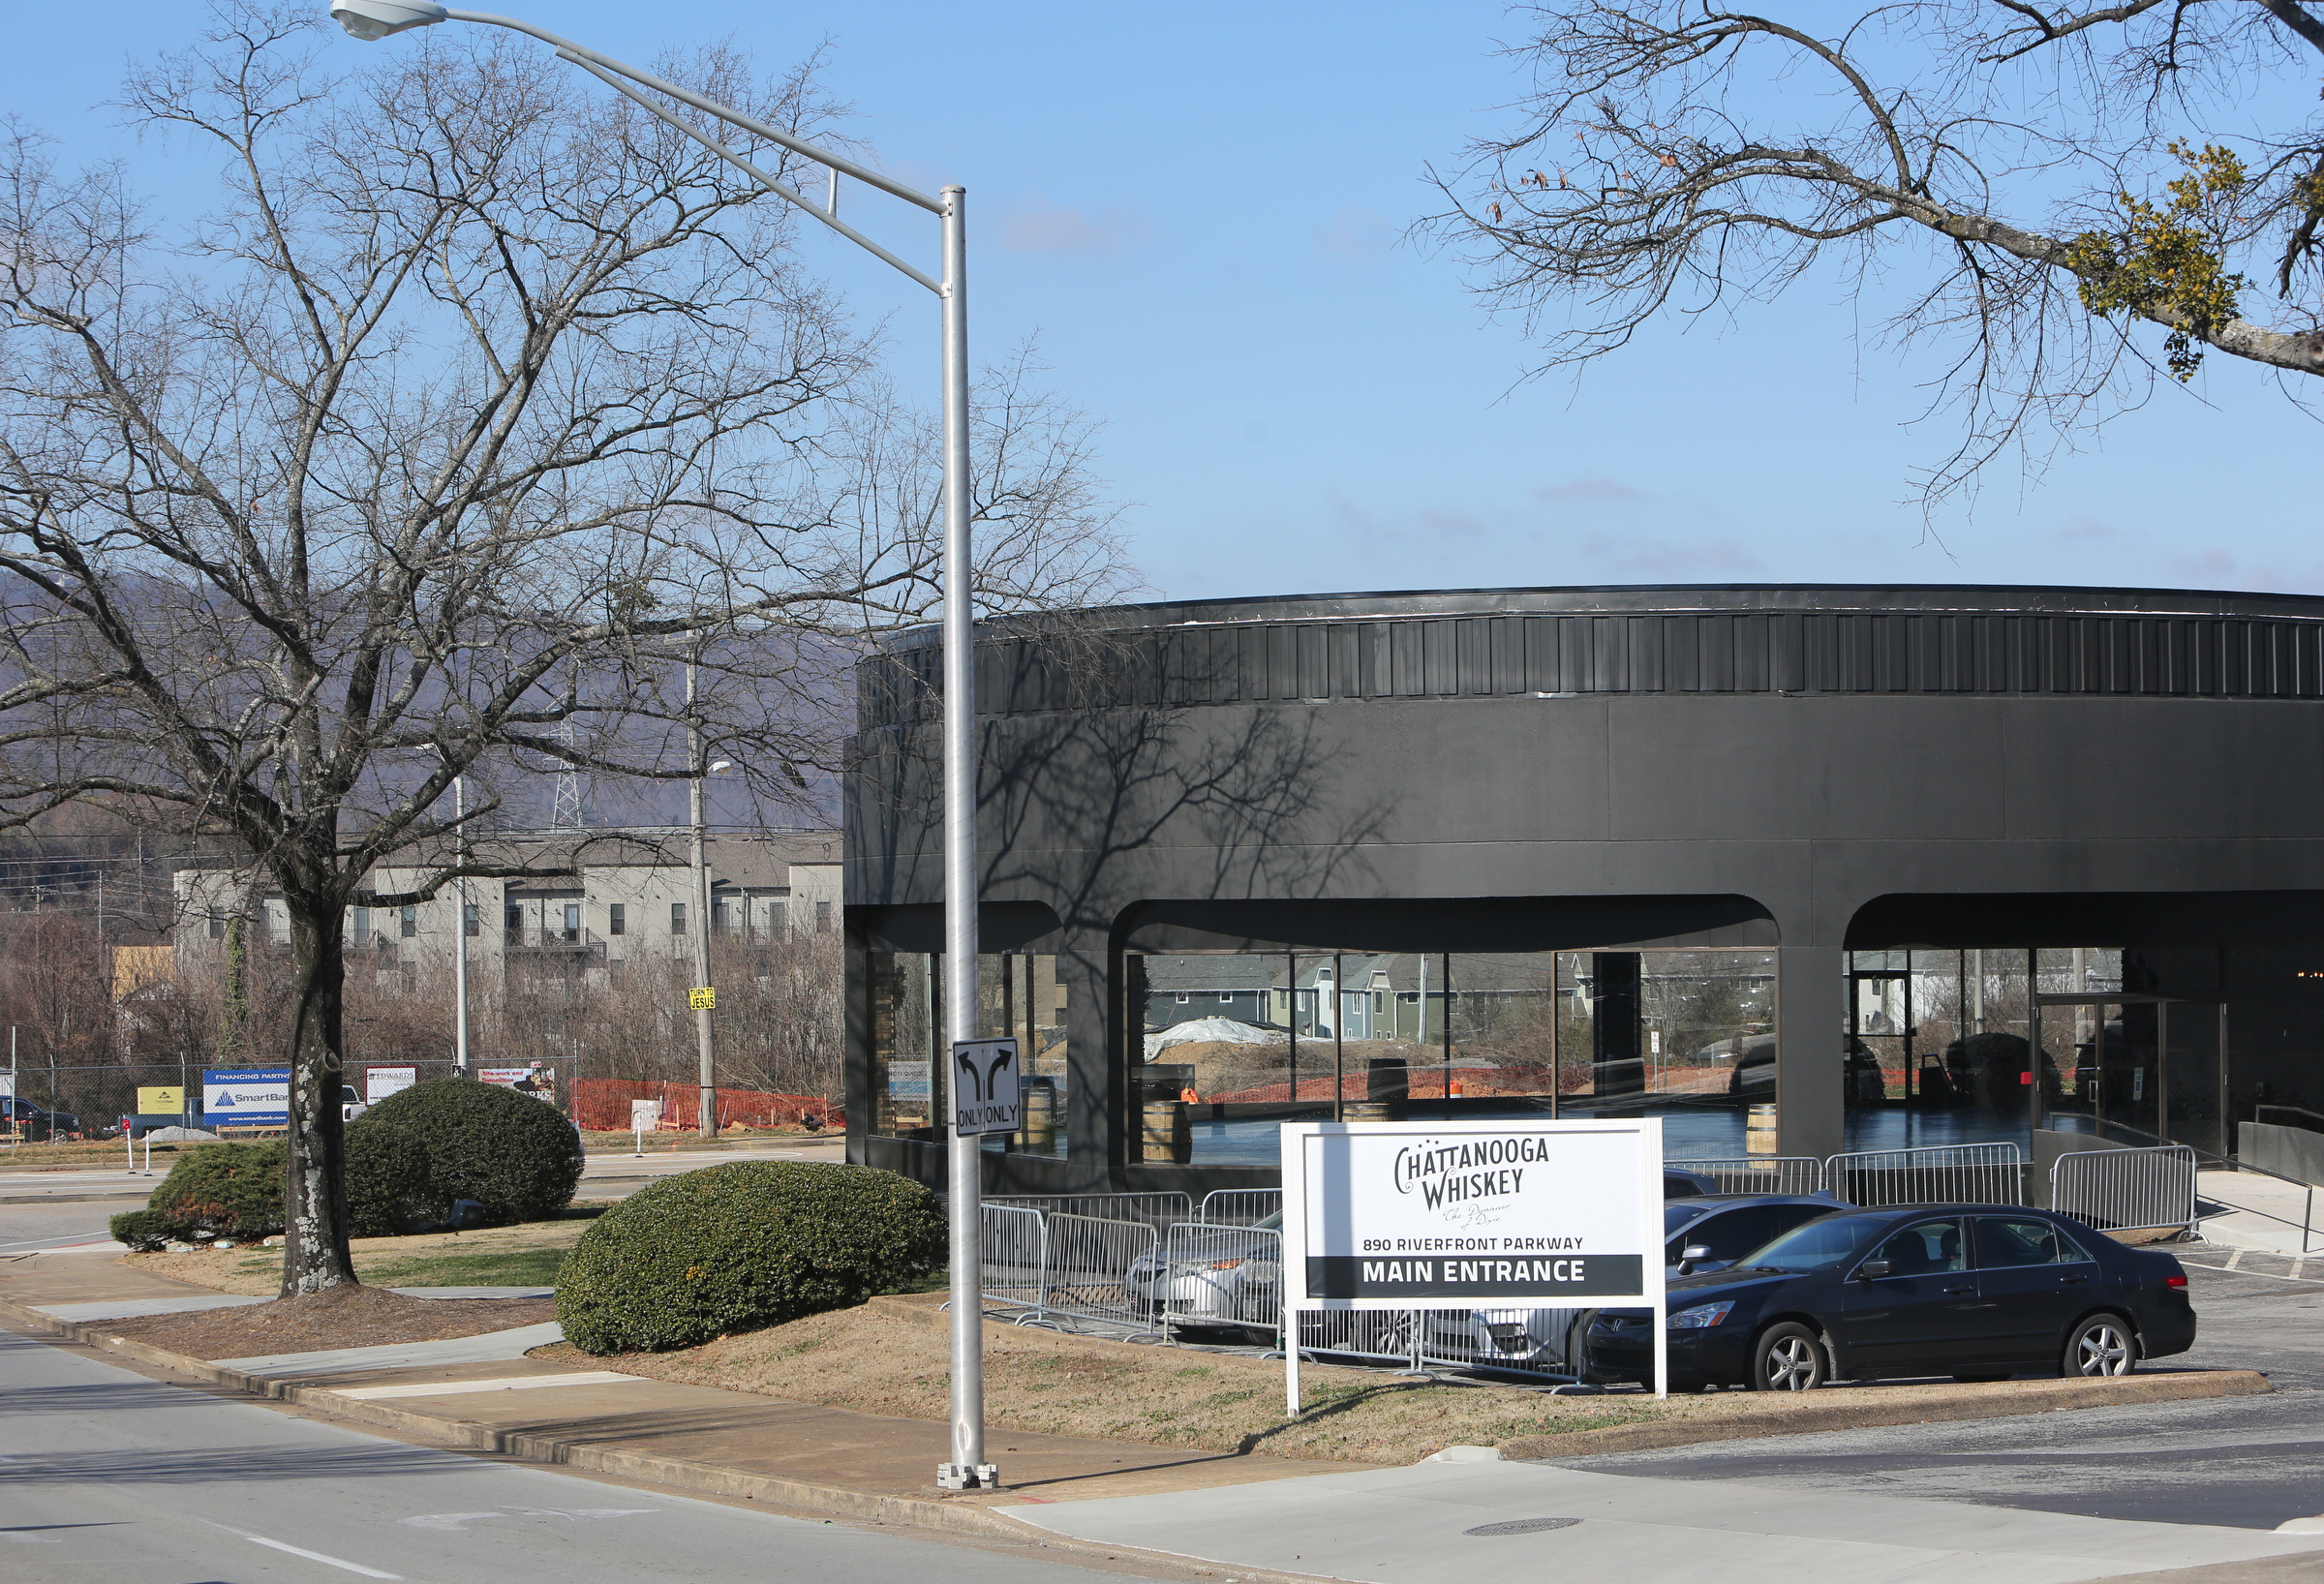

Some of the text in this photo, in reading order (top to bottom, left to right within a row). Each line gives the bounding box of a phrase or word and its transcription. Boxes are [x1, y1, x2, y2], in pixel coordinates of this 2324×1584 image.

[691, 996, 714, 1008] JESUS
[959, 1105, 1018, 1127] ONLY ONLY
[1394, 1138, 1549, 1194] CHATTANOOGA
[1422, 1167, 1523, 1212] WHISKEY
[1443, 1203, 1512, 1221] The Dynamo
[1460, 1213, 1501, 1232] of Dixie
[1362, 1237, 1583, 1251] 890 RIVERFRONT PARKWAY
[1362, 1260, 1585, 1283] MAIN ENTRANCE
